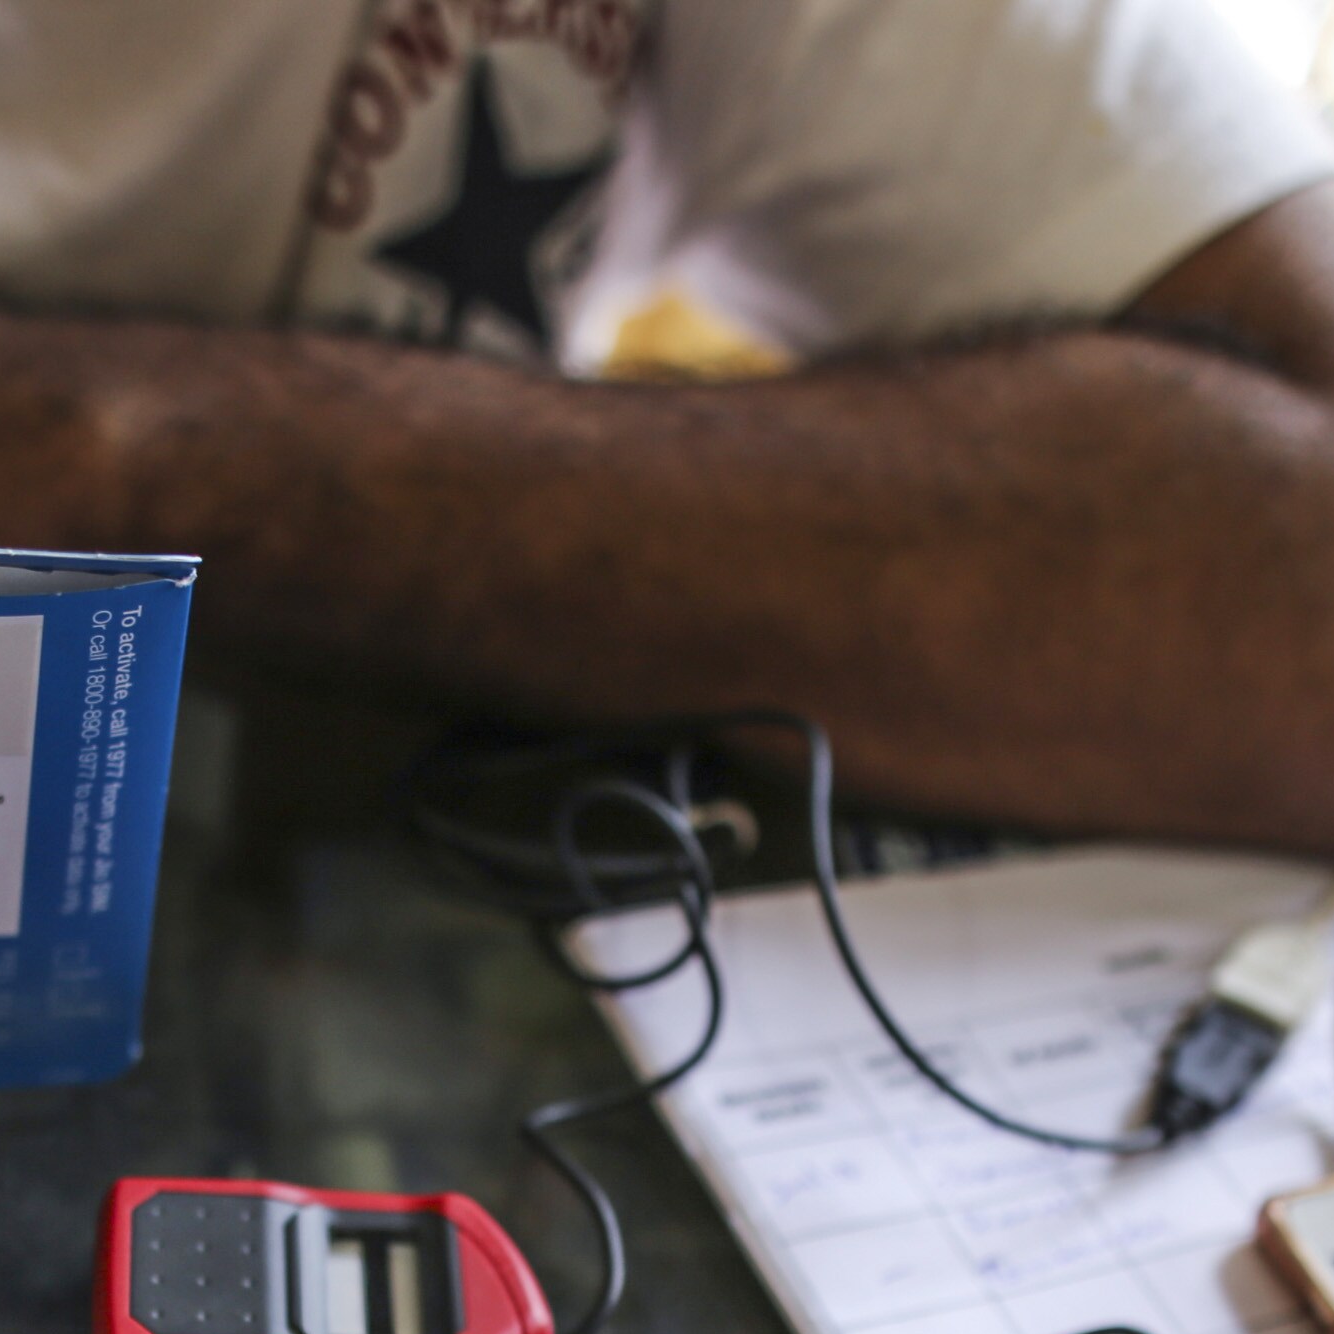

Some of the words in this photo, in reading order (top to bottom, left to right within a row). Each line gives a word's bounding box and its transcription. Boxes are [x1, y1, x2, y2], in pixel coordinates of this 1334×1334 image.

[92, 610, 112, 630] Or
[122, 605, 142, 628] To
[89, 635, 108, 661] call
[110, 632, 136, 705] activate,
[77, 666, 106, 779] 1800-890-1977
[109, 709, 128, 738] call
[105, 741, 126, 778] 1977
